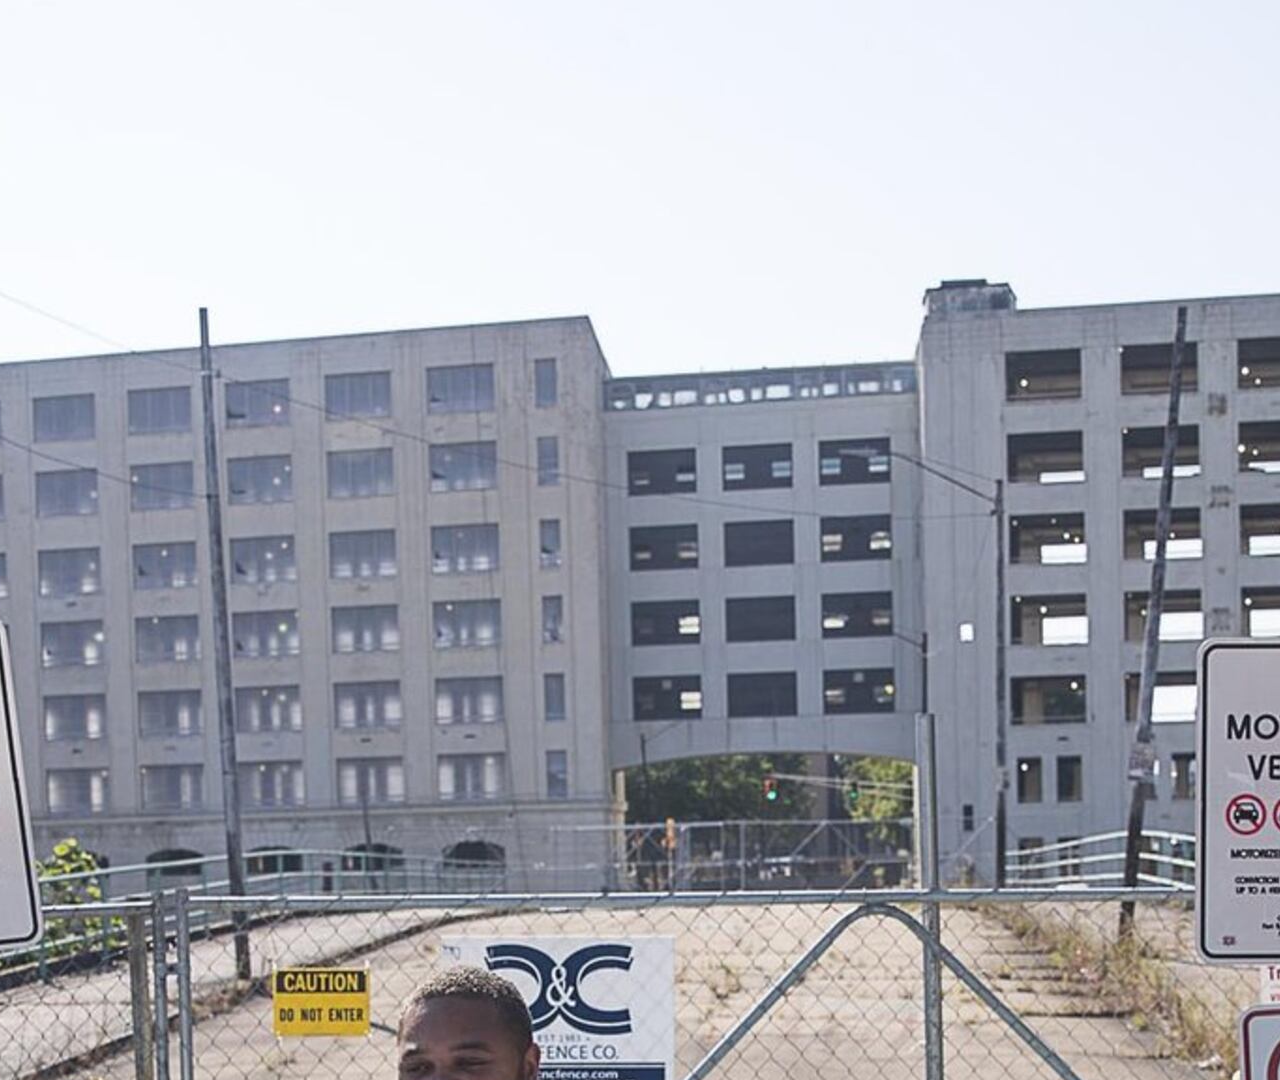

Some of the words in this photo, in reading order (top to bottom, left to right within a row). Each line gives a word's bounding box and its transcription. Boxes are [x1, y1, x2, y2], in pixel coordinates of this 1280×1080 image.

[1235, 876, 1279, 884] CONVICTION
[1236, 886, 1245, 895] UP
[1248, 886, 1259, 895] TO
[1260, 886, 1266, 895] A
[284, 973, 358, 991] CAUTION
[280, 1008, 294, 1022] DO
[301, 1007, 322, 1022] NOT
[329, 1007, 363, 1022] ENTER
[592, 1045, 620, 1060] CO.
